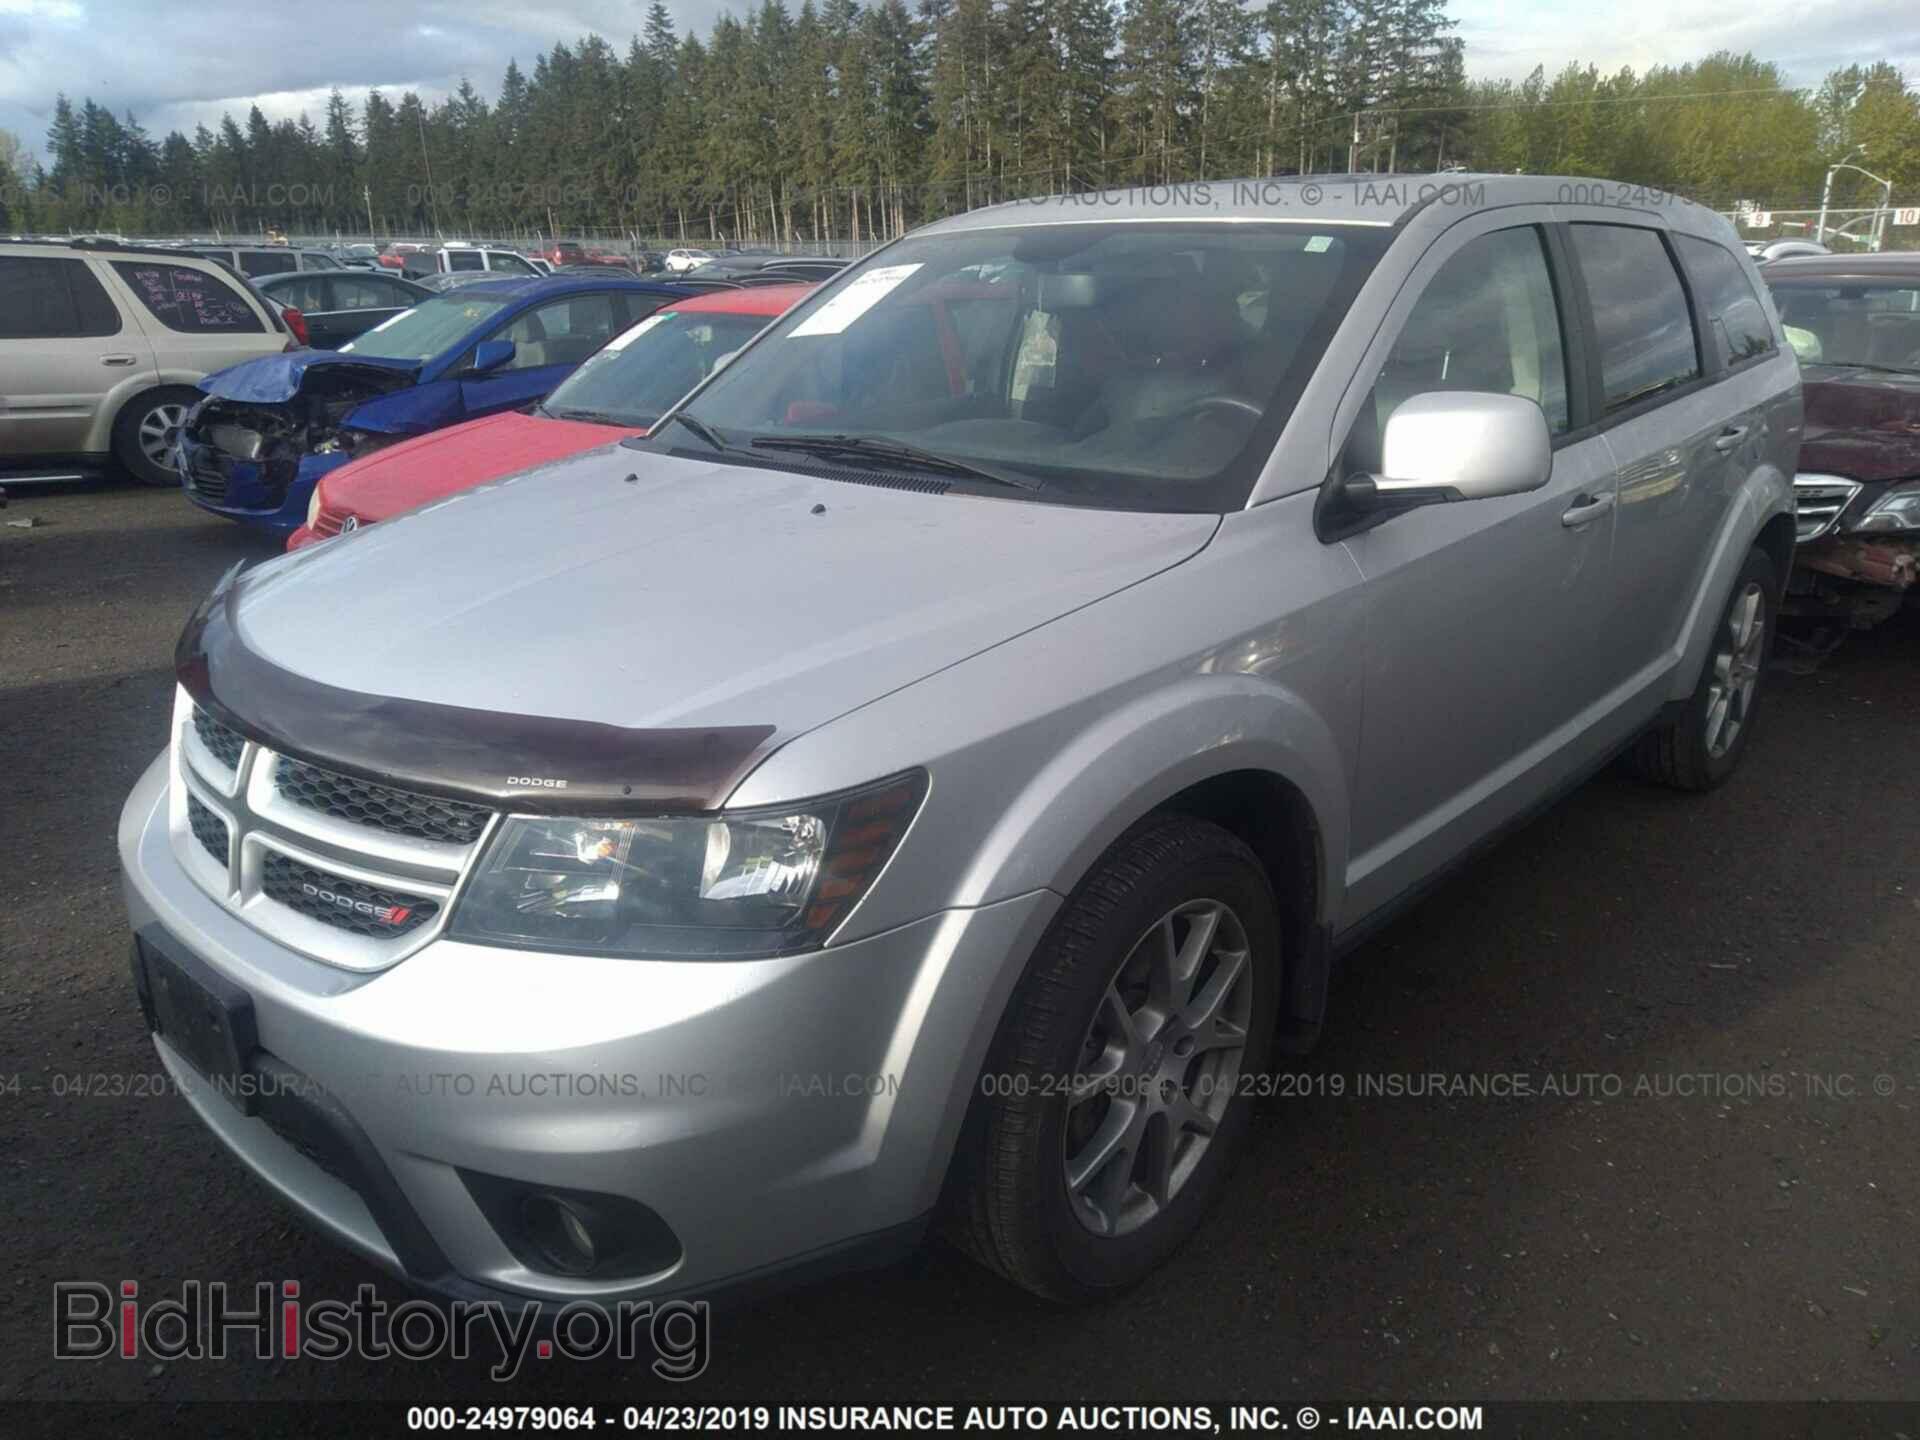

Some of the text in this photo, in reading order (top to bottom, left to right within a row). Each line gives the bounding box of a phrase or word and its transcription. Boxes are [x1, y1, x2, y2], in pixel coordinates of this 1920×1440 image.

[1754, 214, 1765, 226] 9
[1900, 210, 1915, 224] 10
[507, 776, 568, 789] DODGE
[303, 883, 393, 920] DODGE
